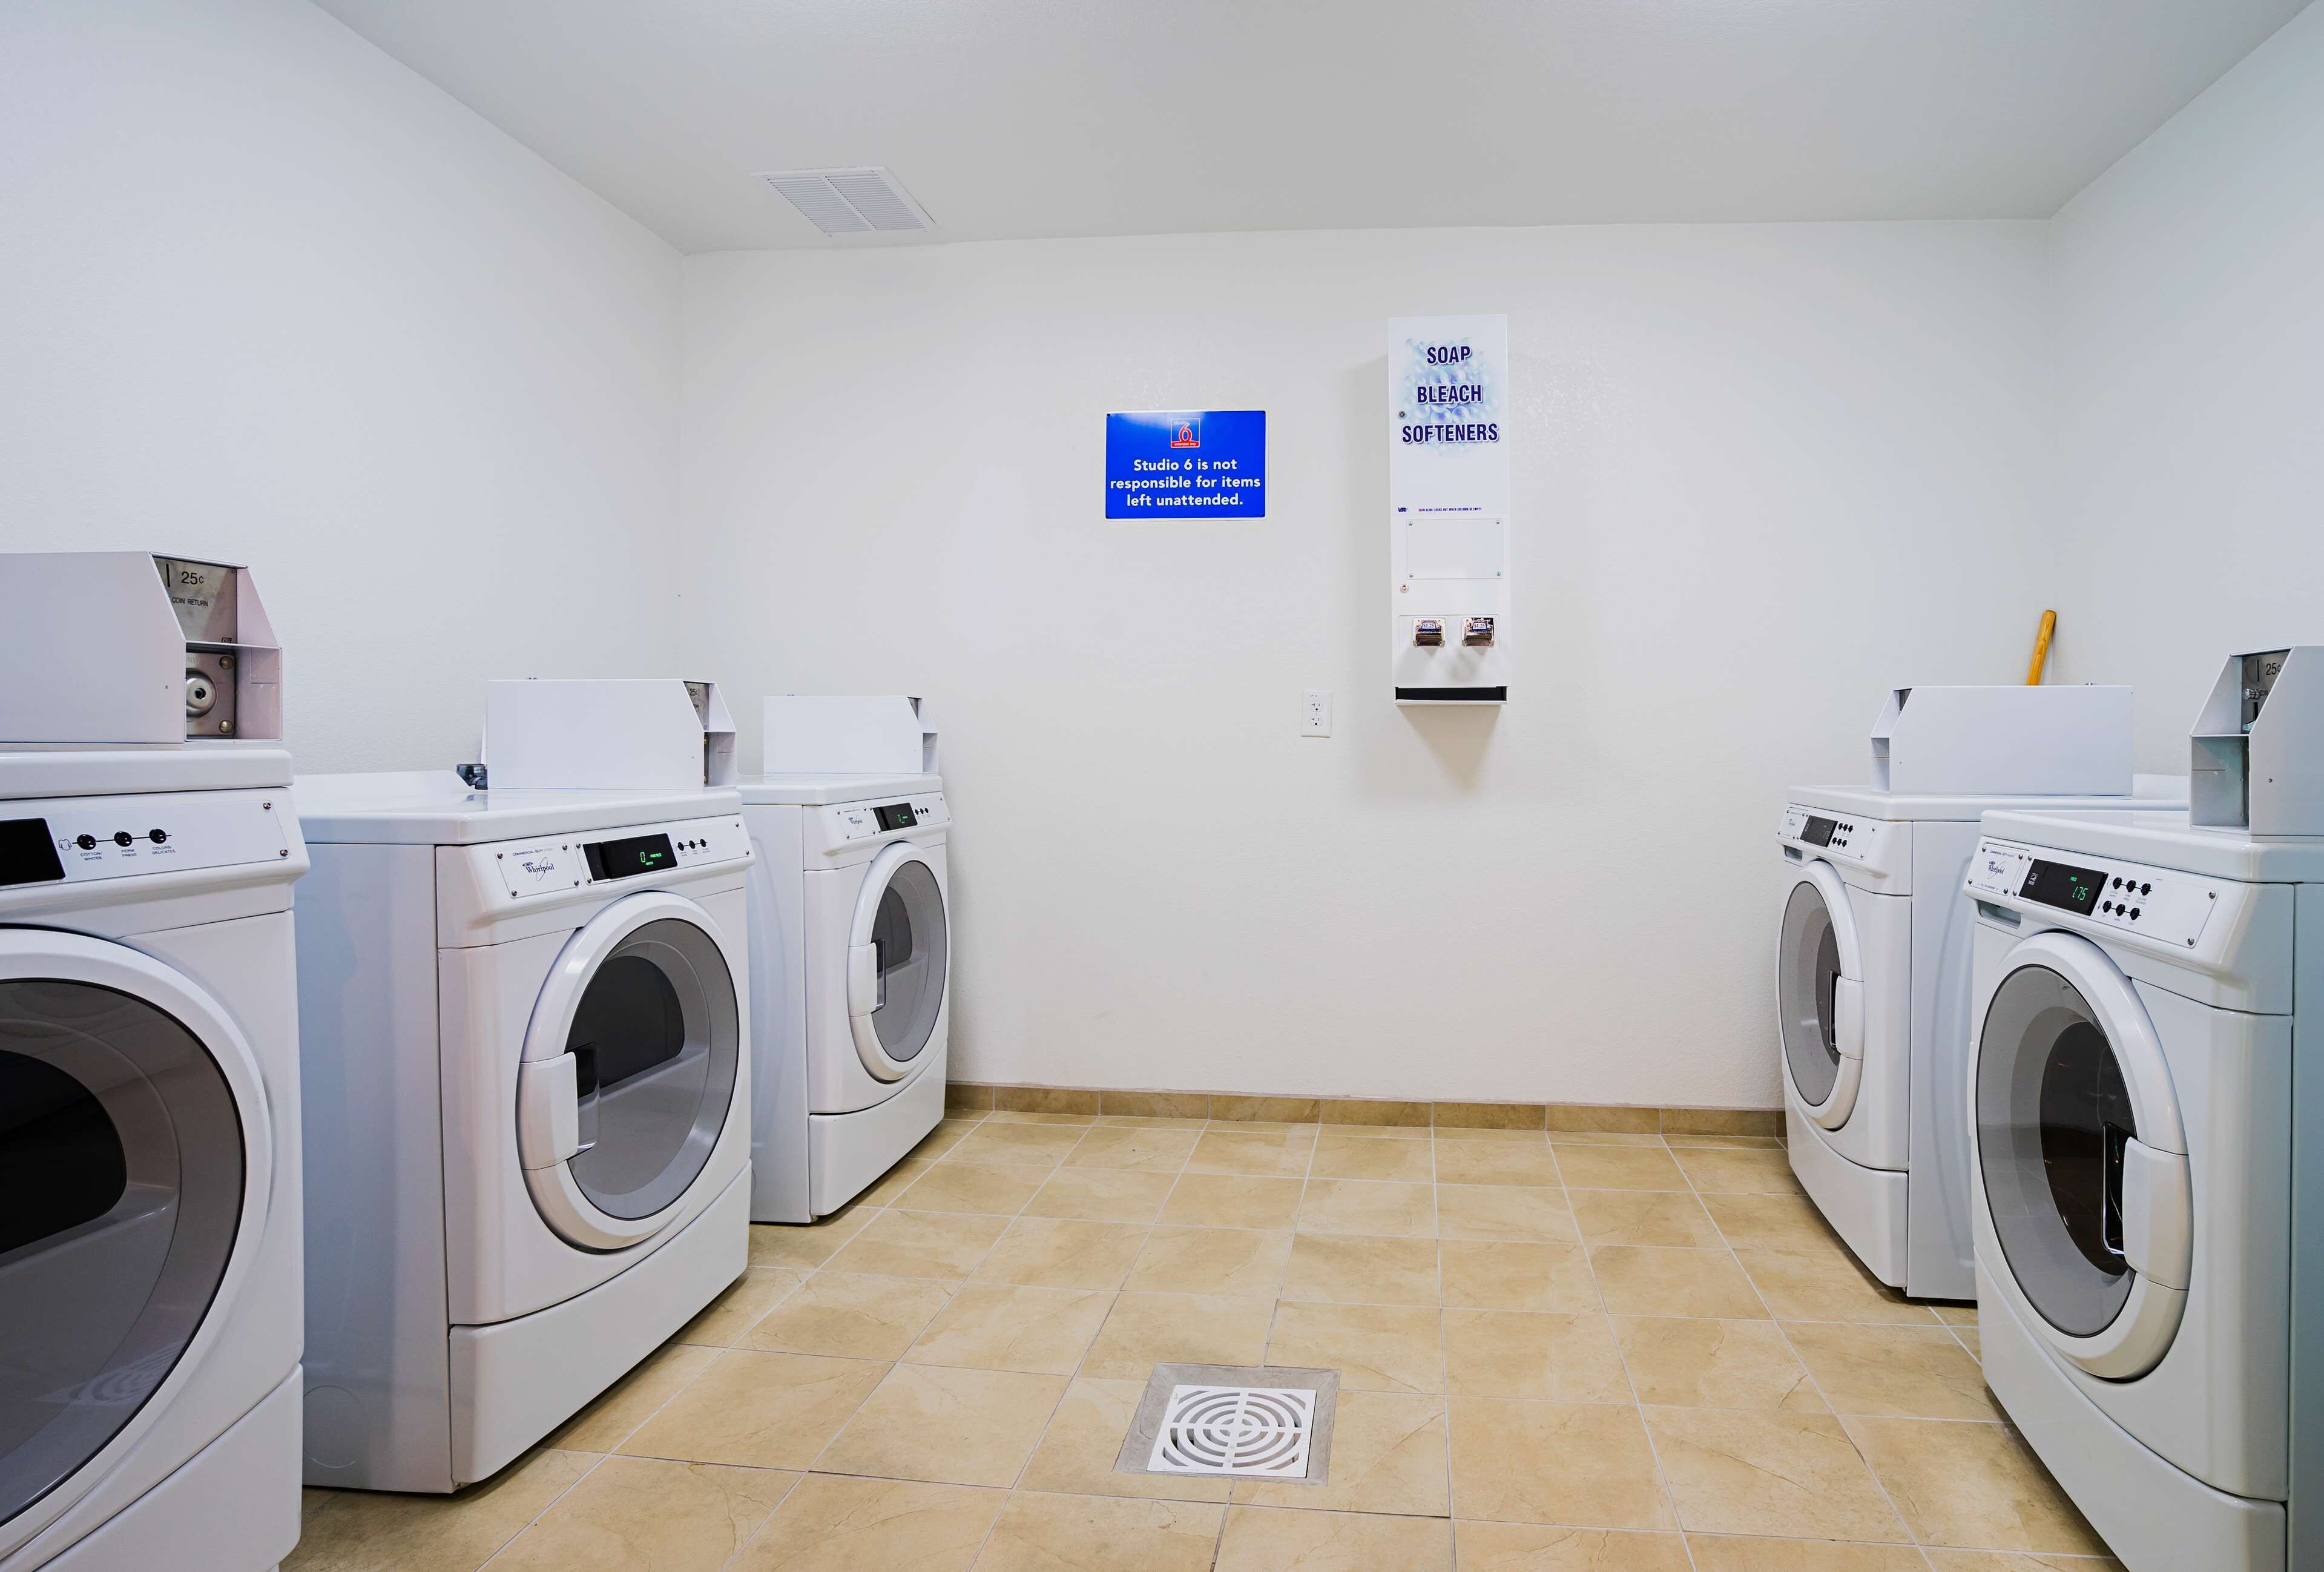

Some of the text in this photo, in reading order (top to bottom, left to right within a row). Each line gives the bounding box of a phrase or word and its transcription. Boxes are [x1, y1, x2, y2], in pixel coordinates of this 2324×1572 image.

[1427, 346, 1471, 364] SOAP
[1417, 385, 1482, 403] BLEACH
[1402, 423, 1498, 443] SOFTENERS
[1133, 458, 1237, 471] Studio 6 is not
[1110, 475, 1261, 492] responsible for items
[1127, 493, 1243, 506] left unattended.
[525, 862, 555, 873] Whirlpool
